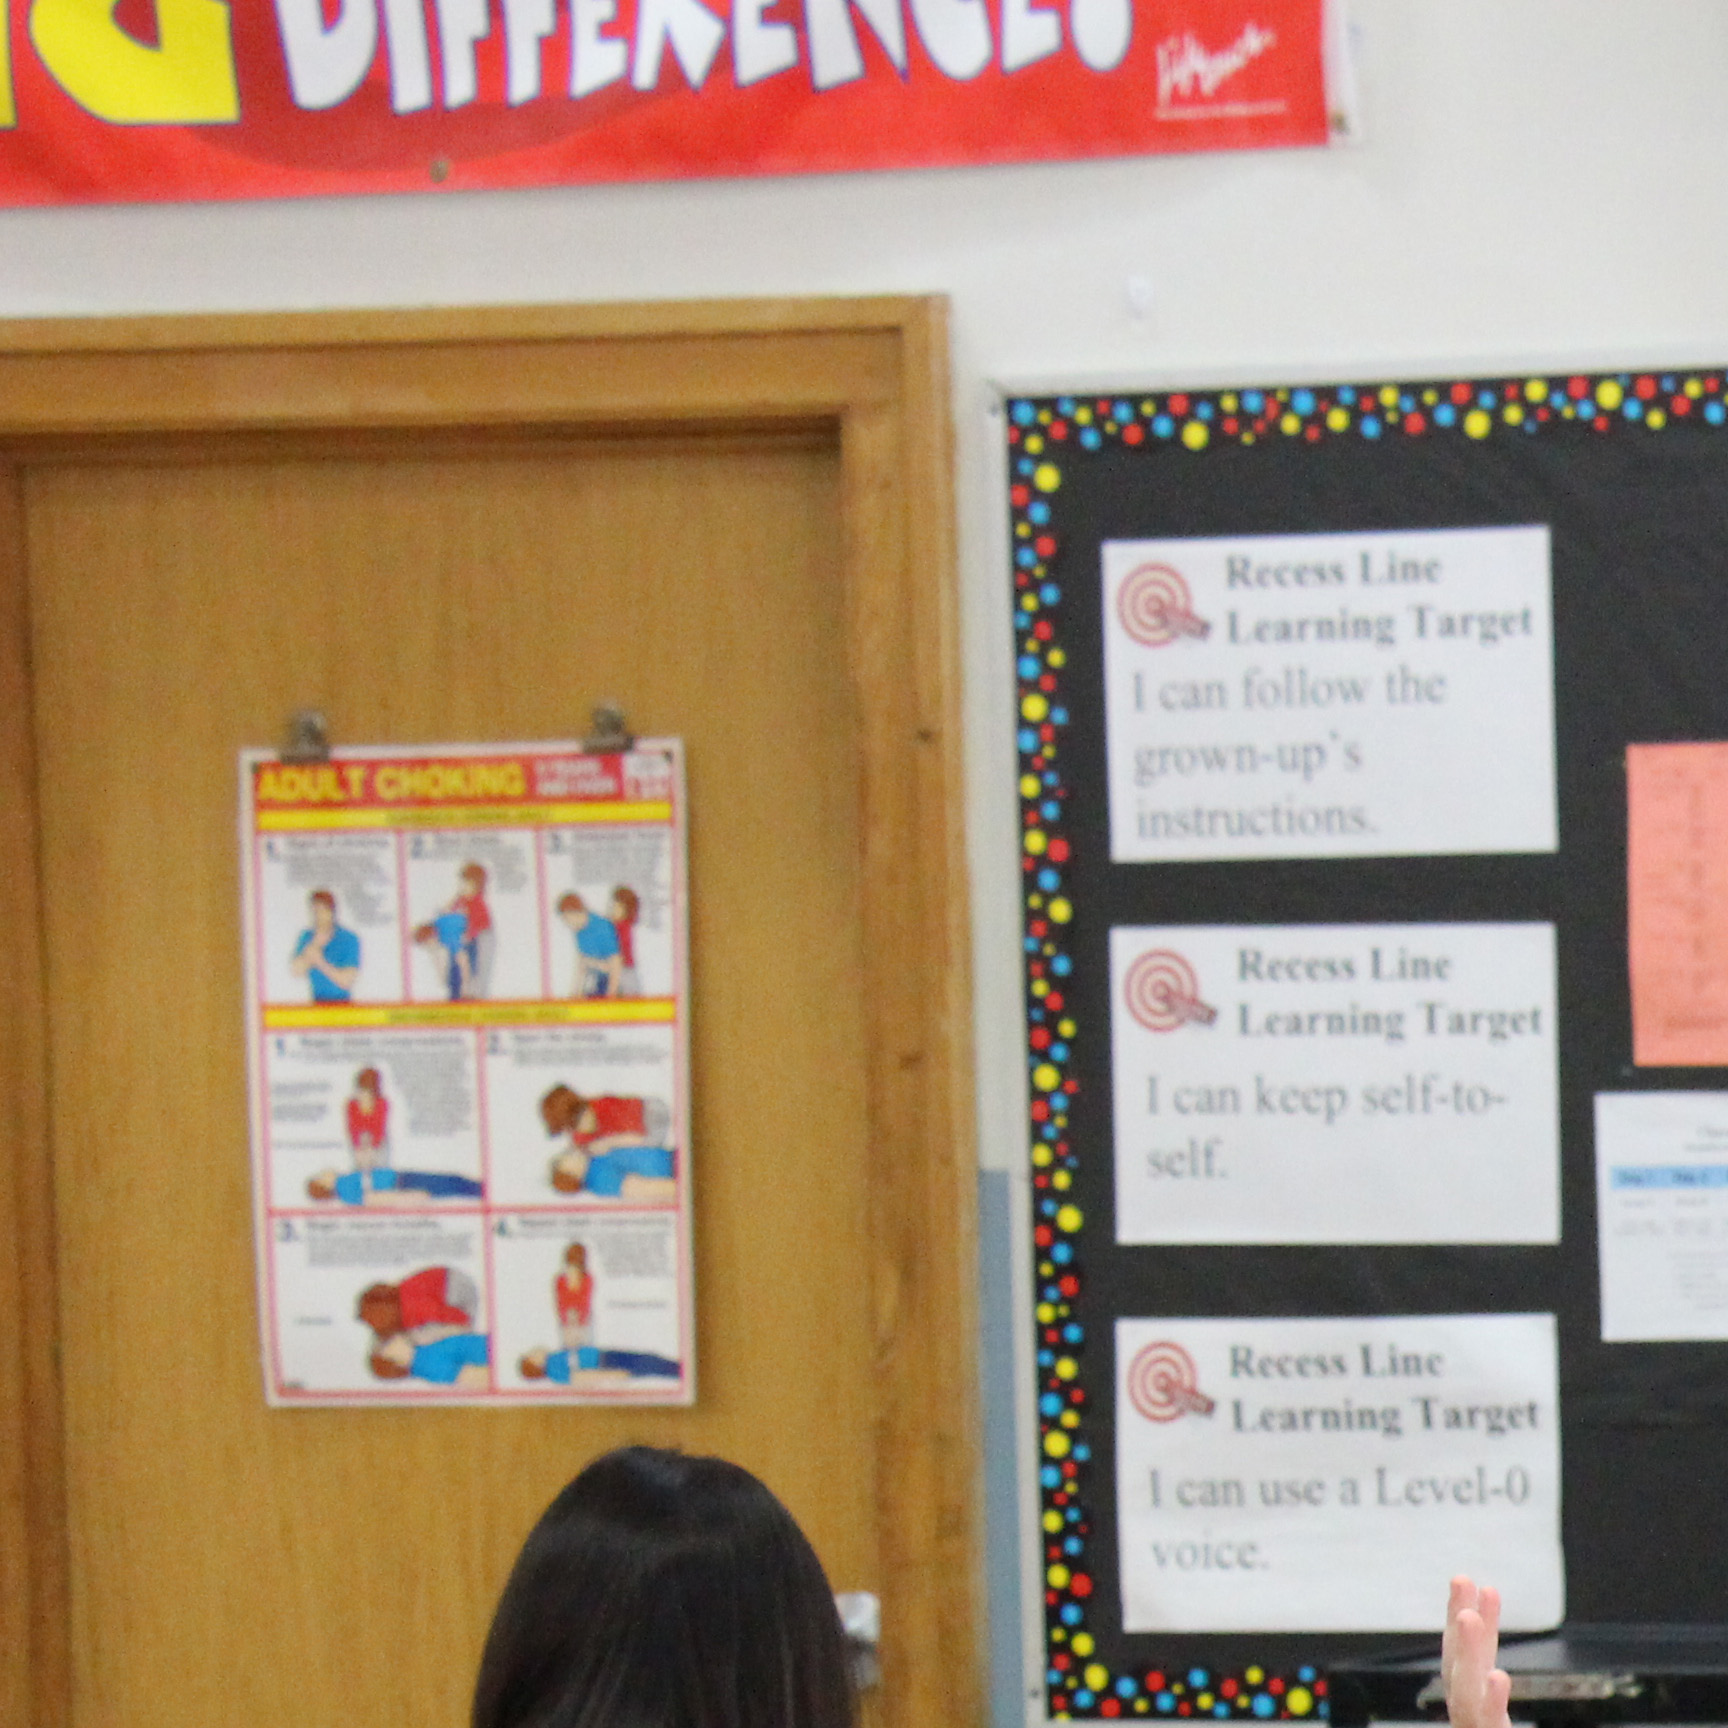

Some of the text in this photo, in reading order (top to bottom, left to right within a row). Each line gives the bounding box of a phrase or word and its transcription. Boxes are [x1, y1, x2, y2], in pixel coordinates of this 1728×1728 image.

[1225, 550, 1441, 590] Recess Line
[1226, 604, 1533, 647] Learning Target
[1132, 663, 1447, 713] I can follow the
[258, 767, 367, 803] ADULT
[376, 762, 527, 799] CHOKING
[1136, 799, 1376, 841] instructions.
[1237, 946, 1451, 982] Recess Line
[1237, 1001, 1542, 1043] Learning Target
[1146, 1075, 1160, 1115] I
[1172, 1086, 1241, 1116] can
[1254, 1074, 1350, 1126] keep
[1146, 1137, 1227, 1180] self.
[1230, 1342, 1443, 1379] Recess Line
[1231, 1396, 1538, 1438] Learning Target
[1148, 1464, 1532, 1509] I can use a Level-0
[1150, 1530, 1268, 1571] voice.
